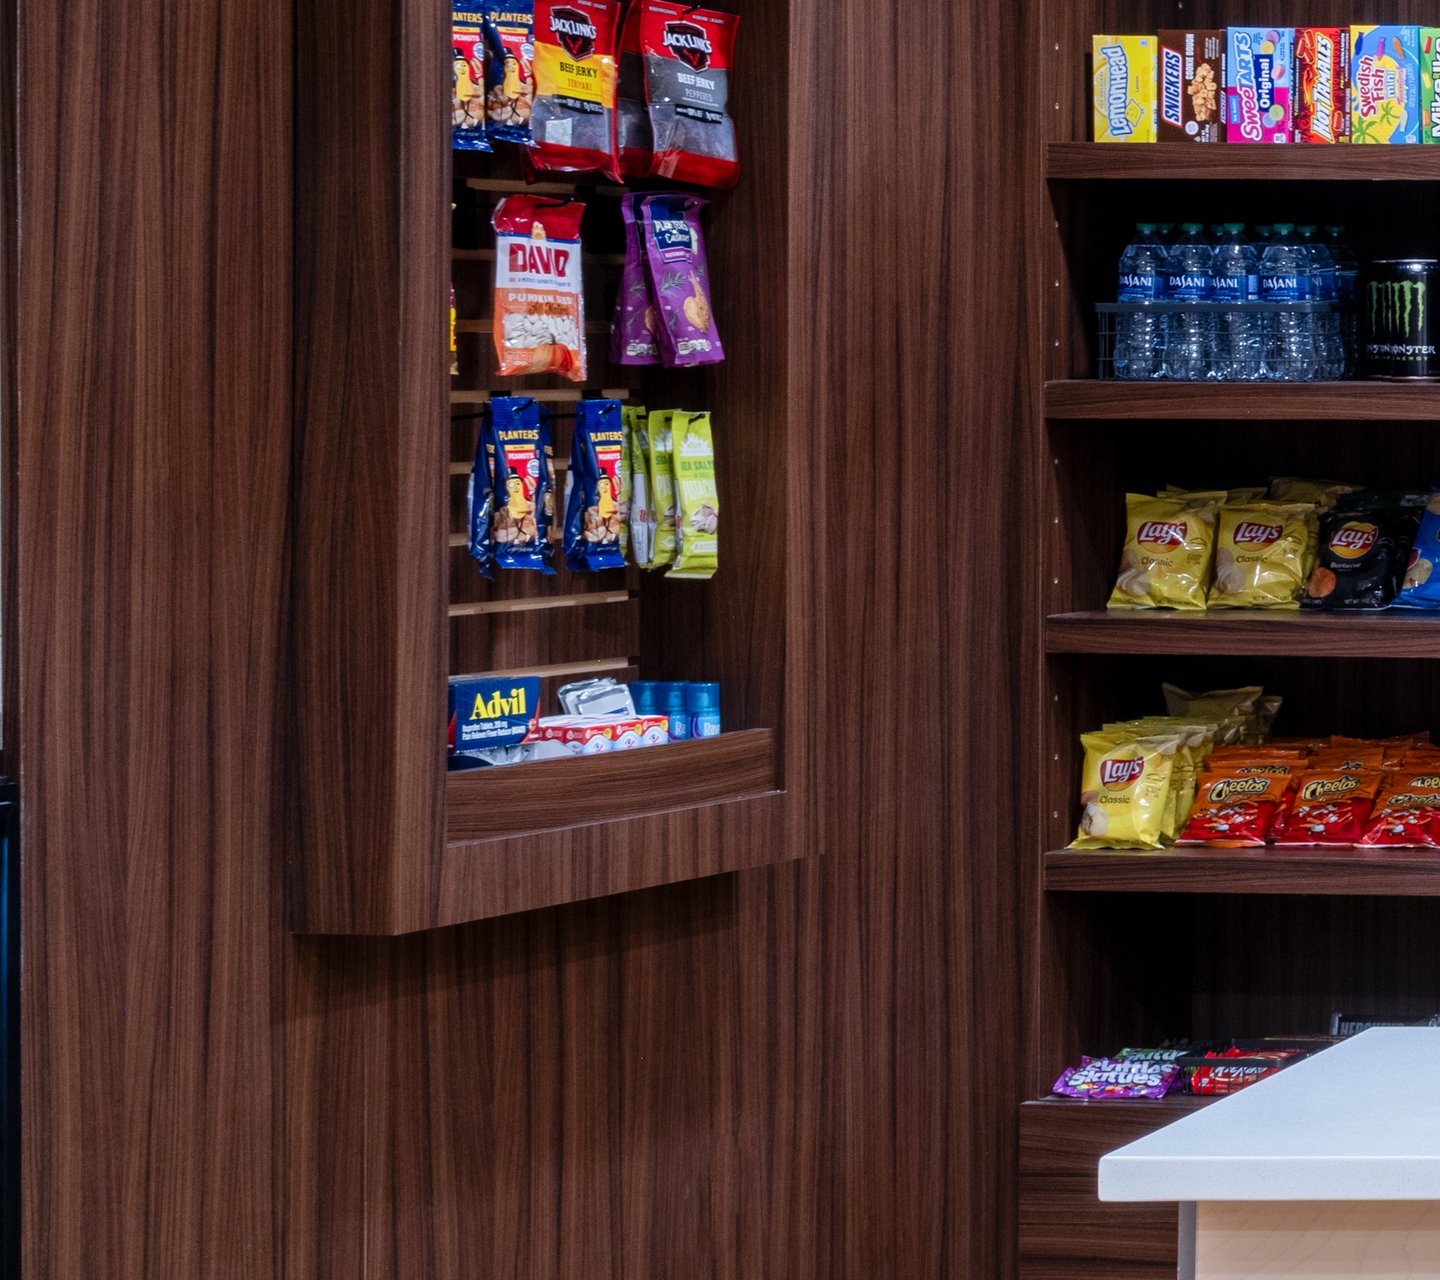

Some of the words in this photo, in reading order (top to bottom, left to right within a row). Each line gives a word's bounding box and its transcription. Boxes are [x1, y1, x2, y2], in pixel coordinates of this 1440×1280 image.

[453, 13, 483, 24] ANTERS
[490, 12, 533, 24] PLANTERS
[550, 16, 572, 34] JACK
[663, 30, 688, 48] JACK
[1186, 34, 1195, 56] DOUGH
[560, 61, 575, 74] BEEF
[575, 64, 598, 79] JERKY
[1186, 57, 1194, 80] COOKIE
[677, 73, 696, 87] BEEF
[695, 76, 715, 90] JERKY
[1164, 51, 1181, 123] SNICKERS
[1259, 58, 1271, 108] Original
[1358, 56, 1376, 118] Swedish
[1371, 68, 1385, 103] Fish
[509, 243, 569, 277] DAVID
[1120, 274, 1152, 289] DASANI
[1169, 274, 1205, 289] DASANI
[1211, 276, 1238, 289] ASANI
[1263, 274, 1297, 290] DASANI
[508, 293, 553, 303] PUMPKIN
[498, 430, 539, 441] PLANTERS
[590, 431, 623, 442] PLANTERS
[1139, 522, 1186, 544] Lay's
[1235, 522, 1279, 544] Lay's
[1331, 528, 1374, 550] Lay's
[1141, 556, 1173, 567] Classic
[1236, 555, 1268, 564] Classic
[469, 687, 527, 720] Advil
[1103, 757, 1143, 782] Lay's
[1210, 778, 1270, 802] Cheetos
[1303, 776, 1360, 801] Cheetos
[1100, 795, 1131, 804] Classic
[1067, 1070, 1161, 1086] Skittles
